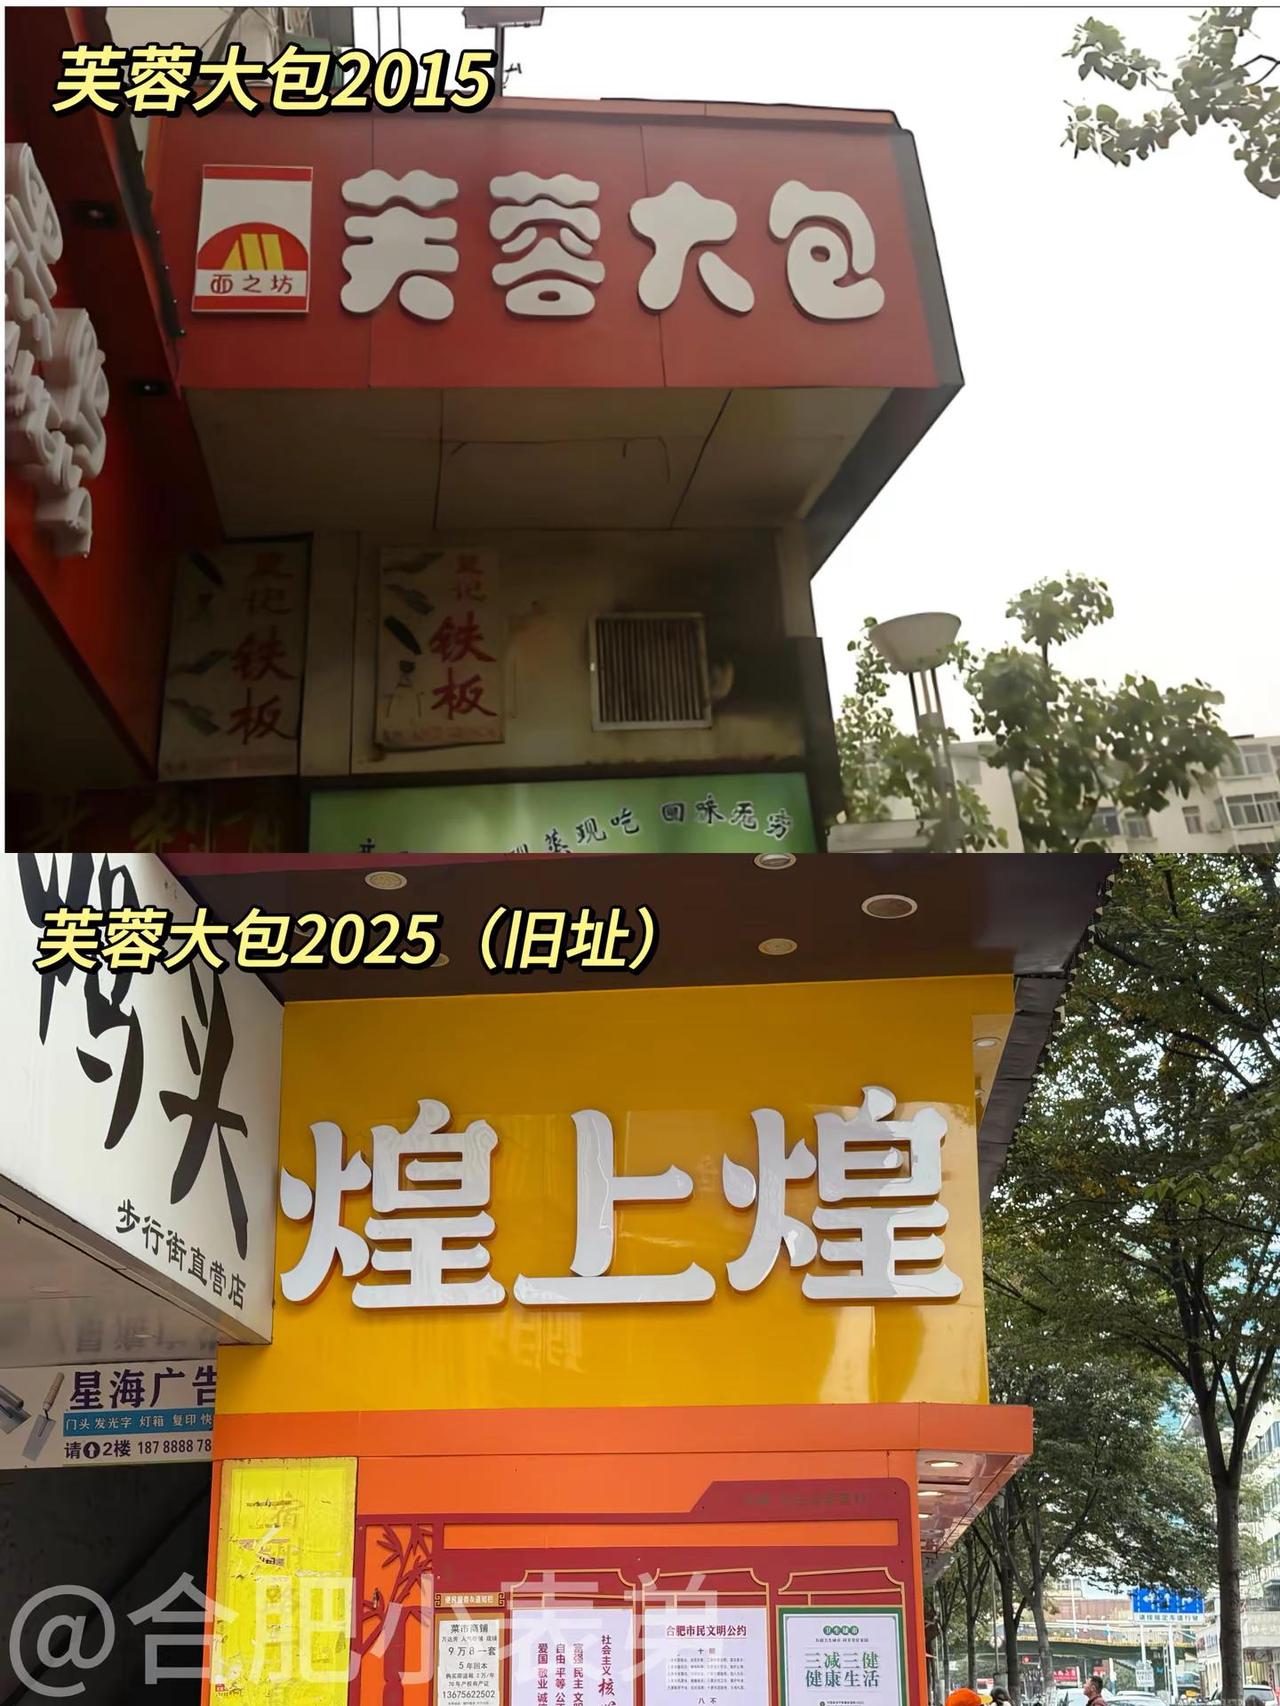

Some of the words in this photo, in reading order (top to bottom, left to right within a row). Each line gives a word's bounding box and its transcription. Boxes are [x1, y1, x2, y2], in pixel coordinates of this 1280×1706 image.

[340, 168, 886, 321] 芙蓉大包
[209, 273, 294, 295] 面之坊
[280, 1085, 964, 1309] 煌上煌
[116, 1199, 248, 1310] 步行街直营店
[69, 1365, 217, 1410] 星海广告
[66, 1418, 90, 1431] 门头
[95, 1416, 133, 1429] 发光字
[139, 1415, 165, 1428] 灯箱
[173, 1413, 197, 1426] 复印
[64, 1442, 82, 1459] 请
[138, 1441, 159, 1455] 187
[163, 1440, 194, 1453] 8888
[665, 1624, 748, 1637] 合肥市民文明公约
[537, 1642, 549, 1665] 爱国
[555, 1643, 566, 1664] 自由
[804, 1651, 879, 1669] 三减三健
[555, 1667, 567, 1689] 平等
[572, 1667, 584, 1689] 民主
[805, 1669, 880, 1688] 健康生活
[442, 1690, 496, 1699] 13675622502
[555, 1692, 567, 1706] 公
[572, 1692, 584, 1706] 文
